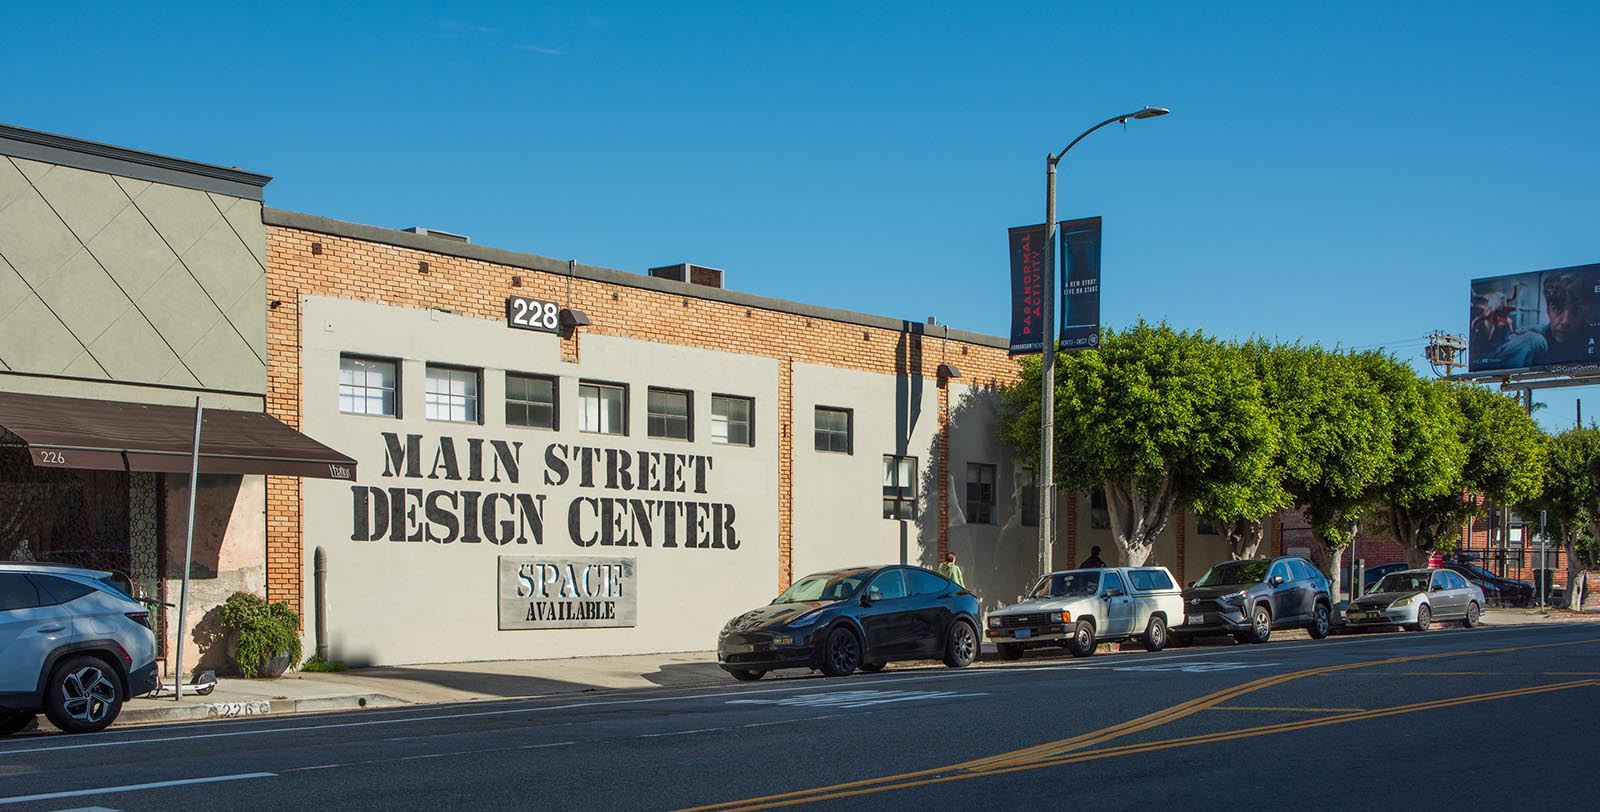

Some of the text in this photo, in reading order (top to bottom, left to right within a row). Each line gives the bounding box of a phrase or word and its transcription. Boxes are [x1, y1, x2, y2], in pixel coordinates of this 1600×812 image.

[1023, 232, 1032, 335] PARANORMAL
[1032, 251, 1041, 317] ACTIVITY
[513, 298, 558, 329] 228
[41, 450, 65, 464] 226
[381, 431, 713, 494] MAIN STREET
[351, 486, 741, 551] DESIGN CENTER
[517, 563, 622, 598] SPACE
[526, 601, 616, 621] AVAILABLE
[222, 702, 254, 718] 226
